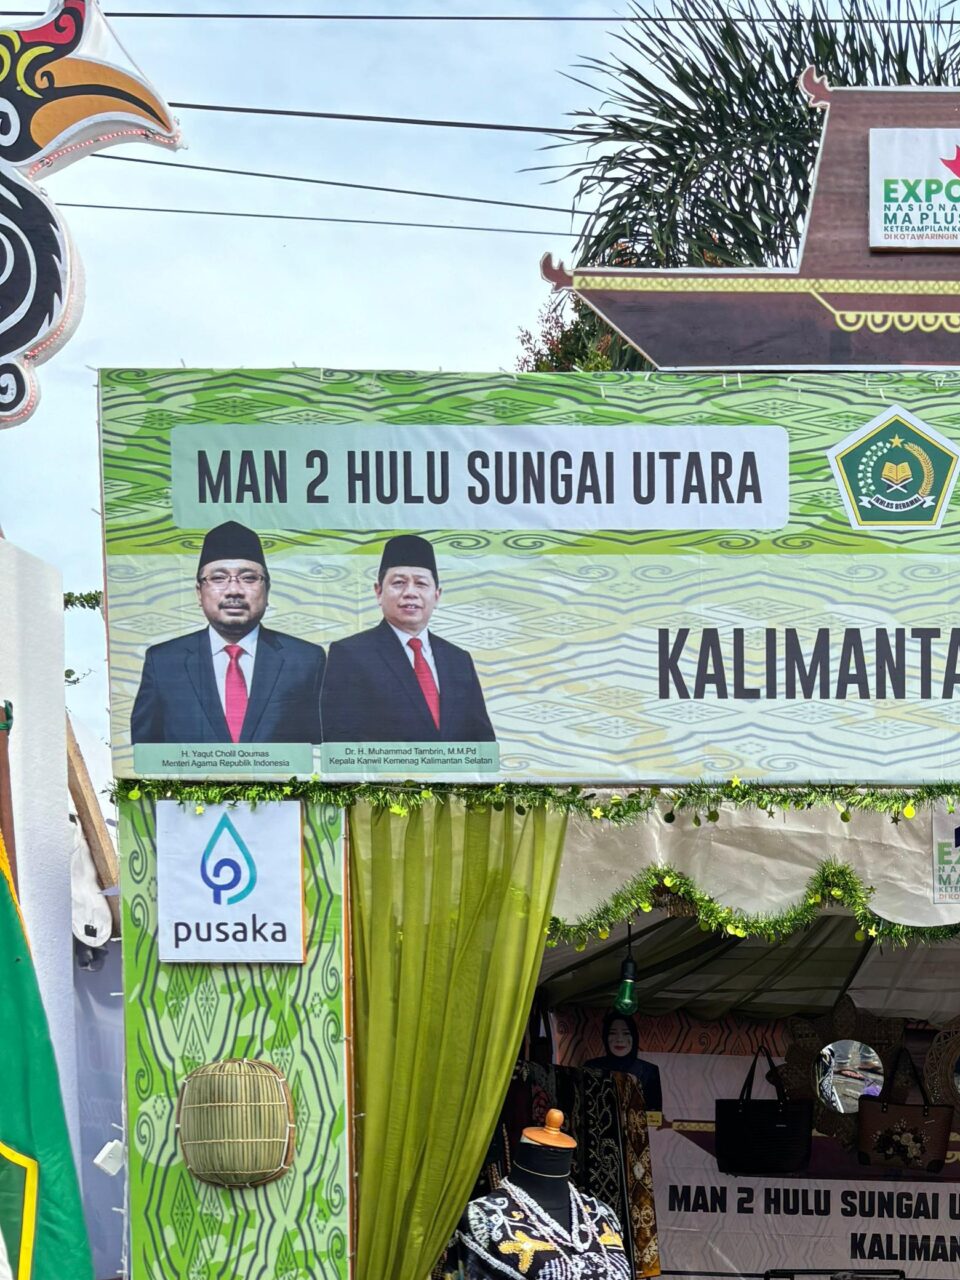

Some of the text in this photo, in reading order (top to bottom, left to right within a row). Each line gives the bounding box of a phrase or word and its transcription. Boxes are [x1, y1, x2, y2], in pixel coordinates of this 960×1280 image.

[884, 212, 913, 225] MA
[893, 233, 958, 241] KOTAWARINGIN
[198, 449, 762, 505] MAN 2 HULU SUNGAI UTARA
[192, 750, 213, 759] Yaqut
[238, 750, 269, 758] Qoumas
[414, 748, 445, 756] Tambrin,
[162, 759, 290, 768] Menteri Agama Republik Indonesia
[329, 757, 493, 766] Kepala Kanwil Kemenag Kalimantan Selatan
[174, 913, 287, 949] pusaka
[668, 1185, 727, 1214] MAN
[737, 1187, 754, 1215] 2
[764, 1188, 830, 1217] HULU
[840, 1190, 940, 1220] SUNGAI
